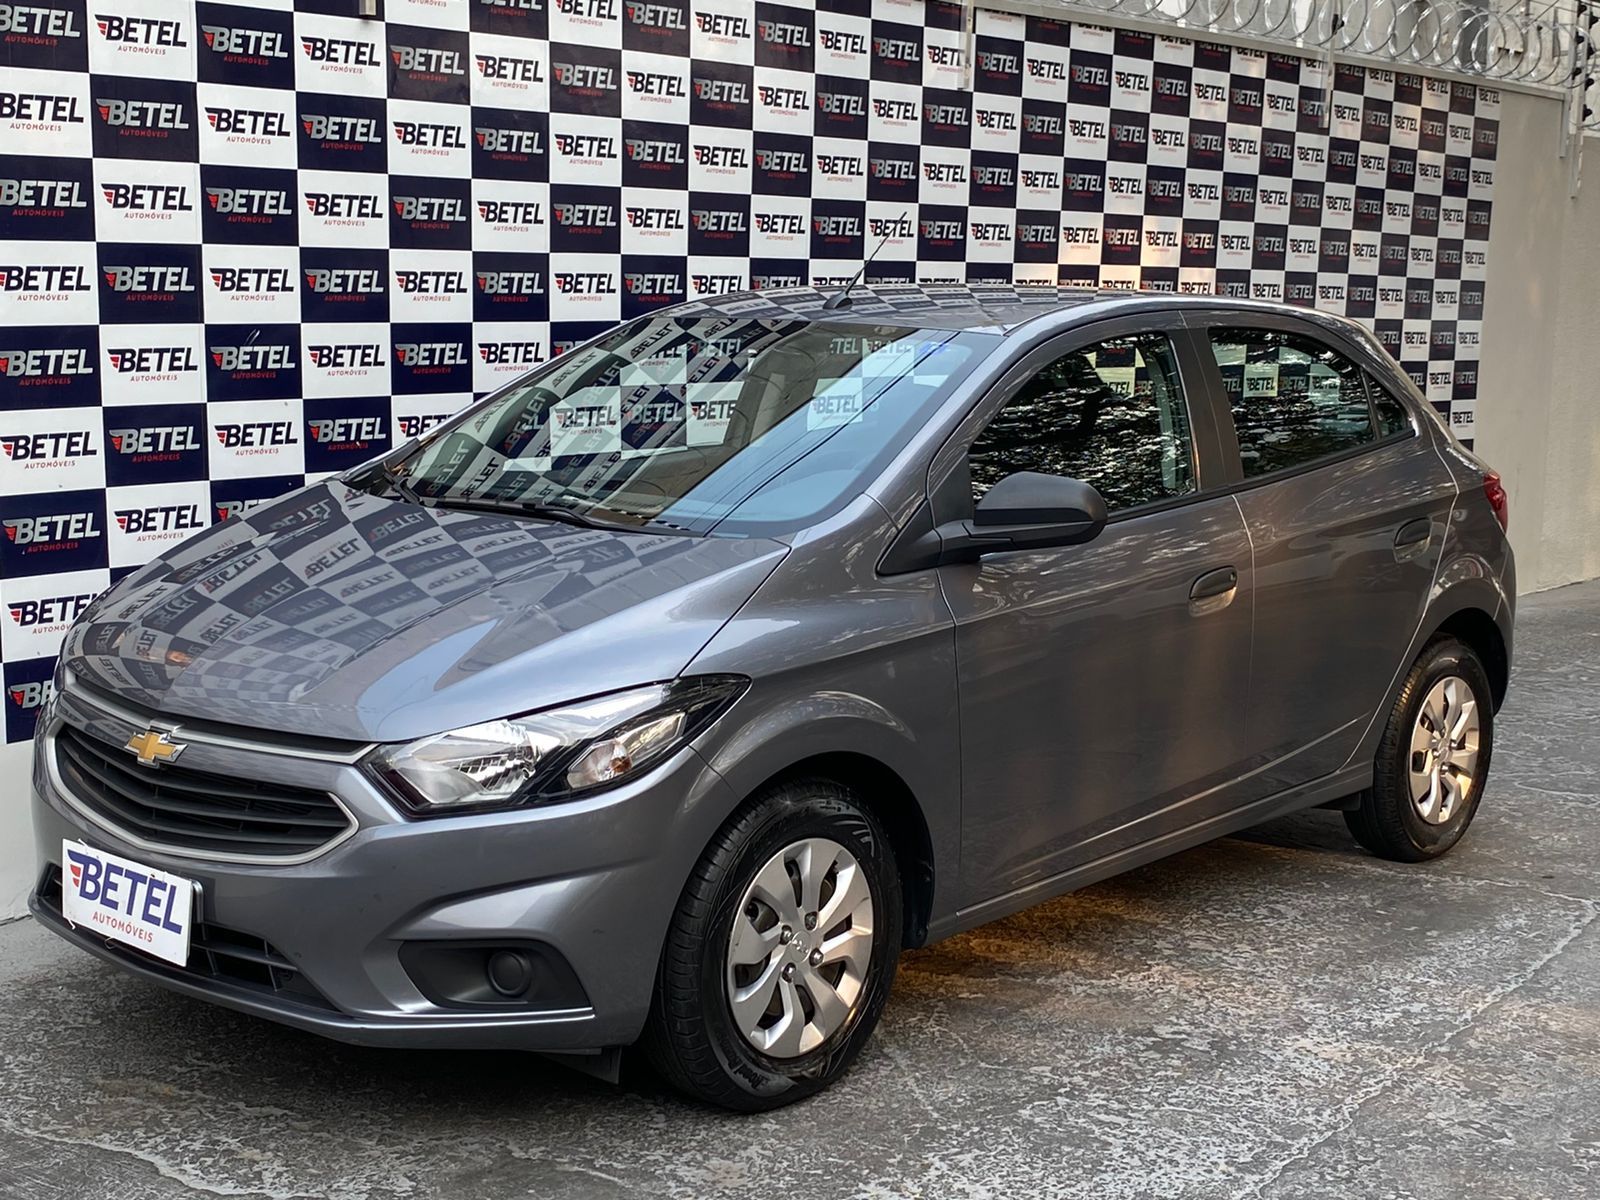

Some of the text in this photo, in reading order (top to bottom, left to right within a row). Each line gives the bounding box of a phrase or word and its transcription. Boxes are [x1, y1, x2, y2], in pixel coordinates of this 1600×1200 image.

[0, 4, 80, 38] BETEL
[558, 0, 617, 21] BETEL
[628, 1, 686, 31] BETEL
[98, 14, 186, 48] BETEL
[697, 11, 750, 39] BETEL
[760, 20, 810, 47] BETEL
[116, 46, 166, 55] AUTOMÓVEIS
[206, 25, 288, 58] BETEL
[304, 36, 380, 67] BETEL
[820, 29, 866, 55] BETEL
[875, 37, 919, 62] BETEL
[394, 45, 464, 76] BETEL
[928, 45, 966, 67] BET
[477, 54, 543, 83] BETEL
[556, 62, 617, 90] BETEL
[1028, 58, 1065, 80] BETEL
[628, 71, 685, 98] BETEL
[696, 78, 749, 104] BETEL
[1115, 71, 1149, 92] BETEL
[1195, 82, 1226, 102] BETEL
[0, 92, 83, 123] BETEL
[759, 86, 809, 111] BETEL
[819, 92, 865, 116] BETEL
[874, 98, 918, 121] BETEL
[1267, 93, 1295, 112] BETEL
[100, 98, 189, 130] BETEL
[208, 107, 290, 137] BETEL
[926, 104, 968, 126] BETEL
[976, 109, 1016, 131] BETEL
[1334, 104, 1360, 122] BETEL
[1394, 114, 1417, 132] BETEL
[10, 122, 61, 132] AUTOMÓVEIS
[305, 114, 381, 143] BETEL
[395, 121, 465, 149] BETEL
[1070, 119, 1105, 139] BETEL
[1152, 128, 1185, 148] BETEL
[1449, 124, 1471, 141] BETEL
[225, 136, 271, 145] AUTOMÓVEIS
[478, 127, 543, 154] BETEL
[556, 133, 617, 159] BETEL
[628, 139, 684, 164] BETEL
[1228, 137, 1258, 155] BETEL
[695, 145, 748, 169] BETEL
[758, 149, 807, 173] BETEL
[818, 154, 863, 176] BETEL
[1361, 154, 1385, 171] BETEL
[872, 158, 916, 180] BETEL
[924, 162, 966, 183] BETEL
[1022, 170, 1059, 189] BETEL
[1419, 162, 1441, 179] BETEL
[1472, 169, 1493, 185] BETEL
[0, 179, 87, 208] BETEL
[1109, 176, 1142, 195] BETEL
[1188, 183, 1219, 200] BETEL
[103, 183, 192, 211] BETEL
[211, 187, 292, 215] BETEL
[307, 192, 383, 218] BETEL
[1260, 189, 1288, 206] BETEL
[1326, 195, 1352, 212] BETEL
[123, 212, 172, 220] AUTOMÓVEIS
[397, 196, 466, 222] BETEL
[479, 200, 543, 225] BETEL
[557, 203, 616, 227] BETEL
[627, 207, 683, 229] BETEL
[1386, 201, 1410, 217] BETEL
[1442, 208, 1464, 223] BETEL
[694, 210, 746, 232] BETEL
[756, 213, 805, 234] BETEL
[815, 216, 861, 236] BETEL
[870, 218, 914, 238] BETEL
[922, 220, 963, 239] BETEL
[971, 222, 1011, 241] BETEL
[1064, 226, 1099, 244] BETEL
[1146, 230, 1178, 247] BETEL
[1221, 234, 1250, 250] BETEL
[1290, 238, 1316, 254] BETEL
[1353, 243, 1377, 258] BETEL
[1411, 247, 1433, 262] BETEL
[1465, 251, 1485, 265] BETEL
[0, 265, 90, 292] BETEL
[107, 266, 194, 292] BETEL
[213, 267, 294, 292] BETEL
[309, 269, 383, 293] BETEL
[398, 270, 467, 293] BETEL
[479, 271, 543, 294] BETEL
[557, 273, 616, 294] BETEL
[628, 273, 683, 294] BETEL
[693, 274, 746, 295] BETEL
[18, 293, 68, 301] AUTOMÓVEIS
[1253, 283, 1281, 298] BETEL
[1319, 285, 1344, 300] BETEL
[1435, 290, 1457, 304] BETEL
[1405, 331, 1427, 345] BETEL
[1459, 331, 1479, 344] BETEL
[1, 349, 93, 376] BETEL
[110, 347, 197, 373] BETEL
[215, 345, 295, 370] BETEL
[310, 344, 385, 368] BETEL
[400, 342, 467, 366] BETEL
[480, 342, 544, 364] BETEL
[129, 374, 178, 382] AUTOMÓVEIS
[1247, 375, 1276, 392] BETEL
[1429, 372, 1451, 385] BETEL
[627, 401, 684, 425] BETEL
[813, 394, 860, 415] BETEL
[1452, 411, 1473, 423] BETEL
[113, 425, 200, 454] BETEL
[217, 421, 297, 448] BETEL
[313, 417, 386, 443] BETEL
[5, 431, 96, 460] BETEL
[235, 448, 279, 456] AUTOMÓVEIS
[25, 460, 74, 469] AUTOMÓVEIS
[9, 513, 100, 543] BETEL
[118, 504, 204, 534] BETEL
[136, 532, 183, 542] AUTOMÓVEIS
[8, 593, 100, 627] BETE
[32, 623, 71, 635] AUTOMÓV
[70, 848, 183, 936] BETEL
[92, 910, 154, 944] AUTOMÓVEIS
